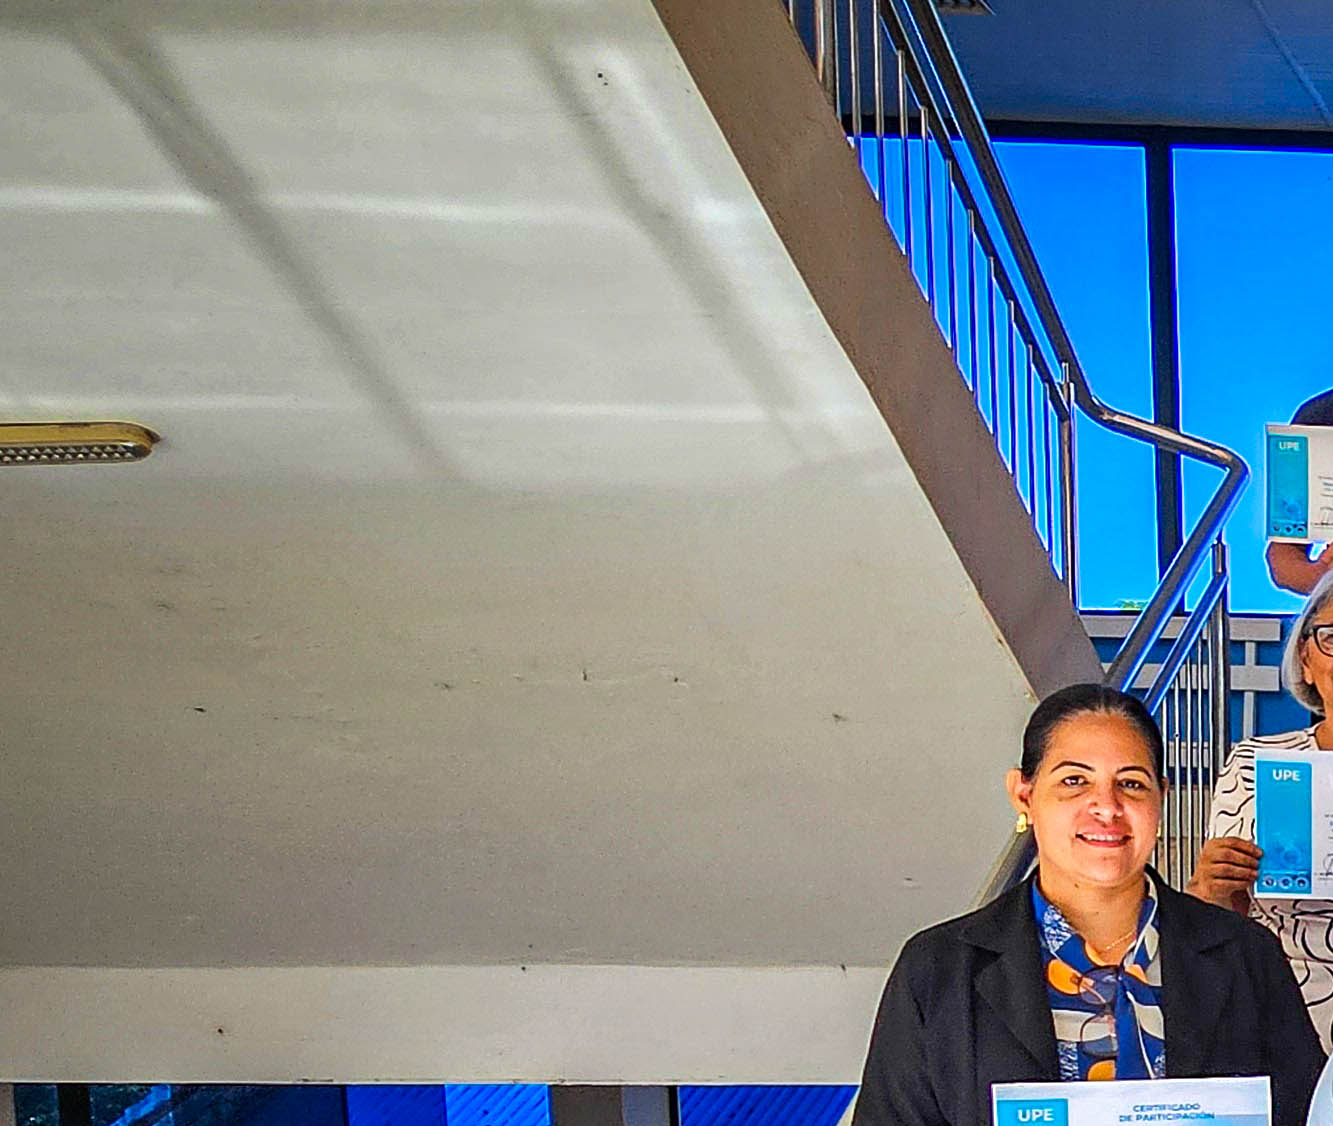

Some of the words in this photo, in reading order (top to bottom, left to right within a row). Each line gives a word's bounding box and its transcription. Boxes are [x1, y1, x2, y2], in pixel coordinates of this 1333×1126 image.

[1273, 769, 1301, 781] UPE
[1132, 1103, 1201, 1112] CERTIFICADO
[1018, 1108, 1054, 1122] UPE
